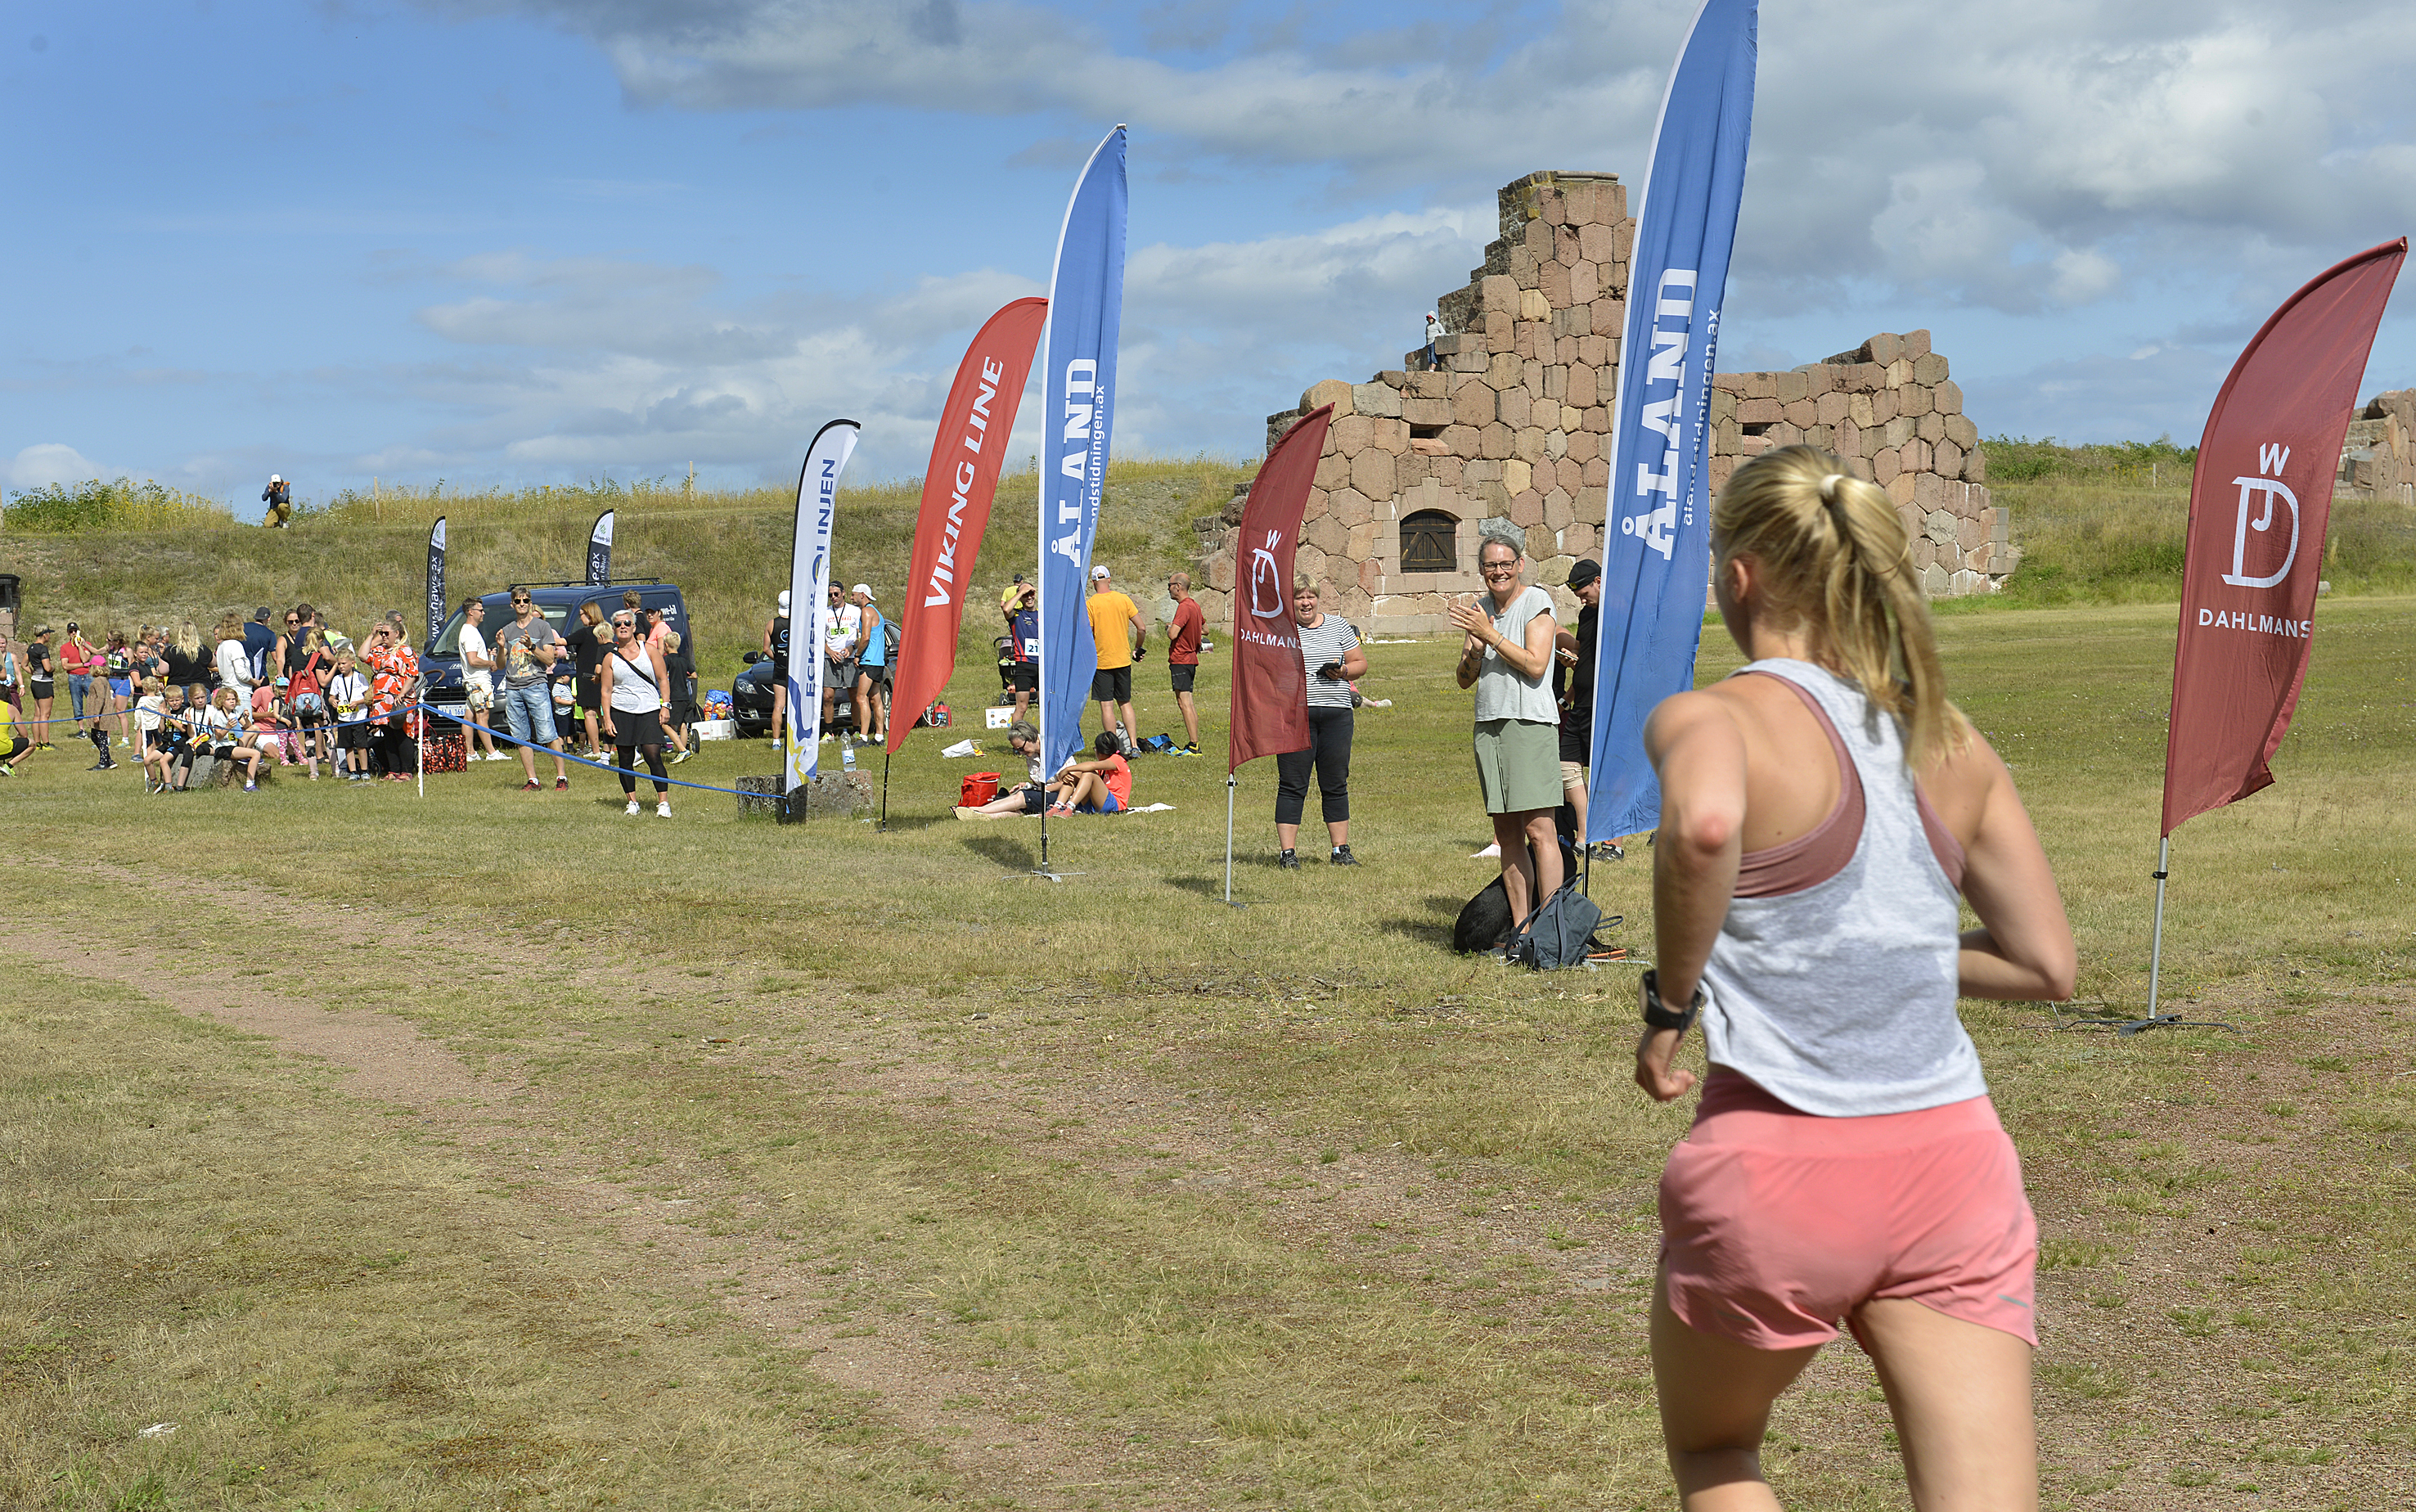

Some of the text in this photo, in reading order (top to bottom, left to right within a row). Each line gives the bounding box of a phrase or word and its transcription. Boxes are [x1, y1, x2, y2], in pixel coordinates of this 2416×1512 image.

[925, 356, 1003, 608] VIKING LINE
[1051, 358, 1097, 568] ÅLAND
[1088, 385, 1105, 530] ndstidningen.ax
[1622, 269, 1698, 560] ÅLAND
[2259, 443, 2290, 476] W
[2198, 608, 2312, 638] DAHLMANS
